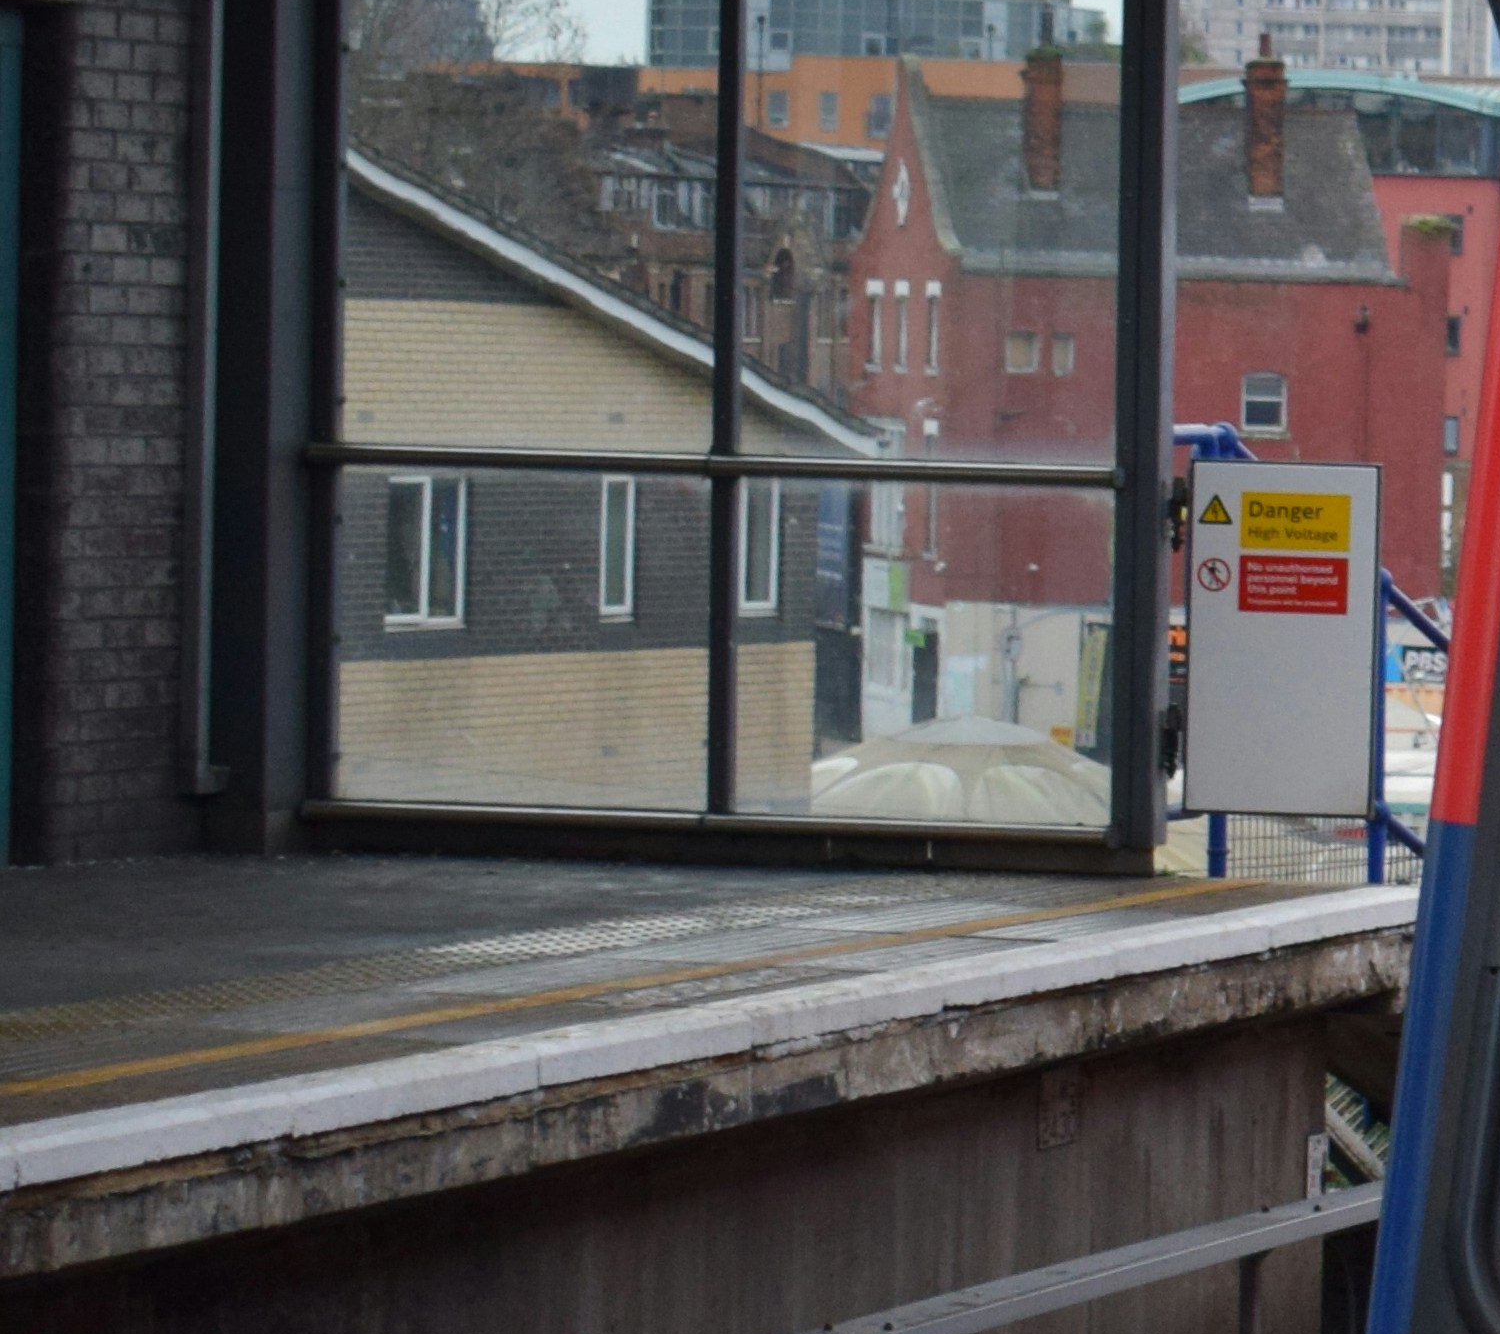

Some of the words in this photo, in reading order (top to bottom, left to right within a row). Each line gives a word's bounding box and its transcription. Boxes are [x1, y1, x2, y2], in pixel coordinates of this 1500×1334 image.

[1248, 500, 1324, 523] Danger
[1247, 527, 1280, 542] High
[1284, 528, 1338, 544] Voltage
